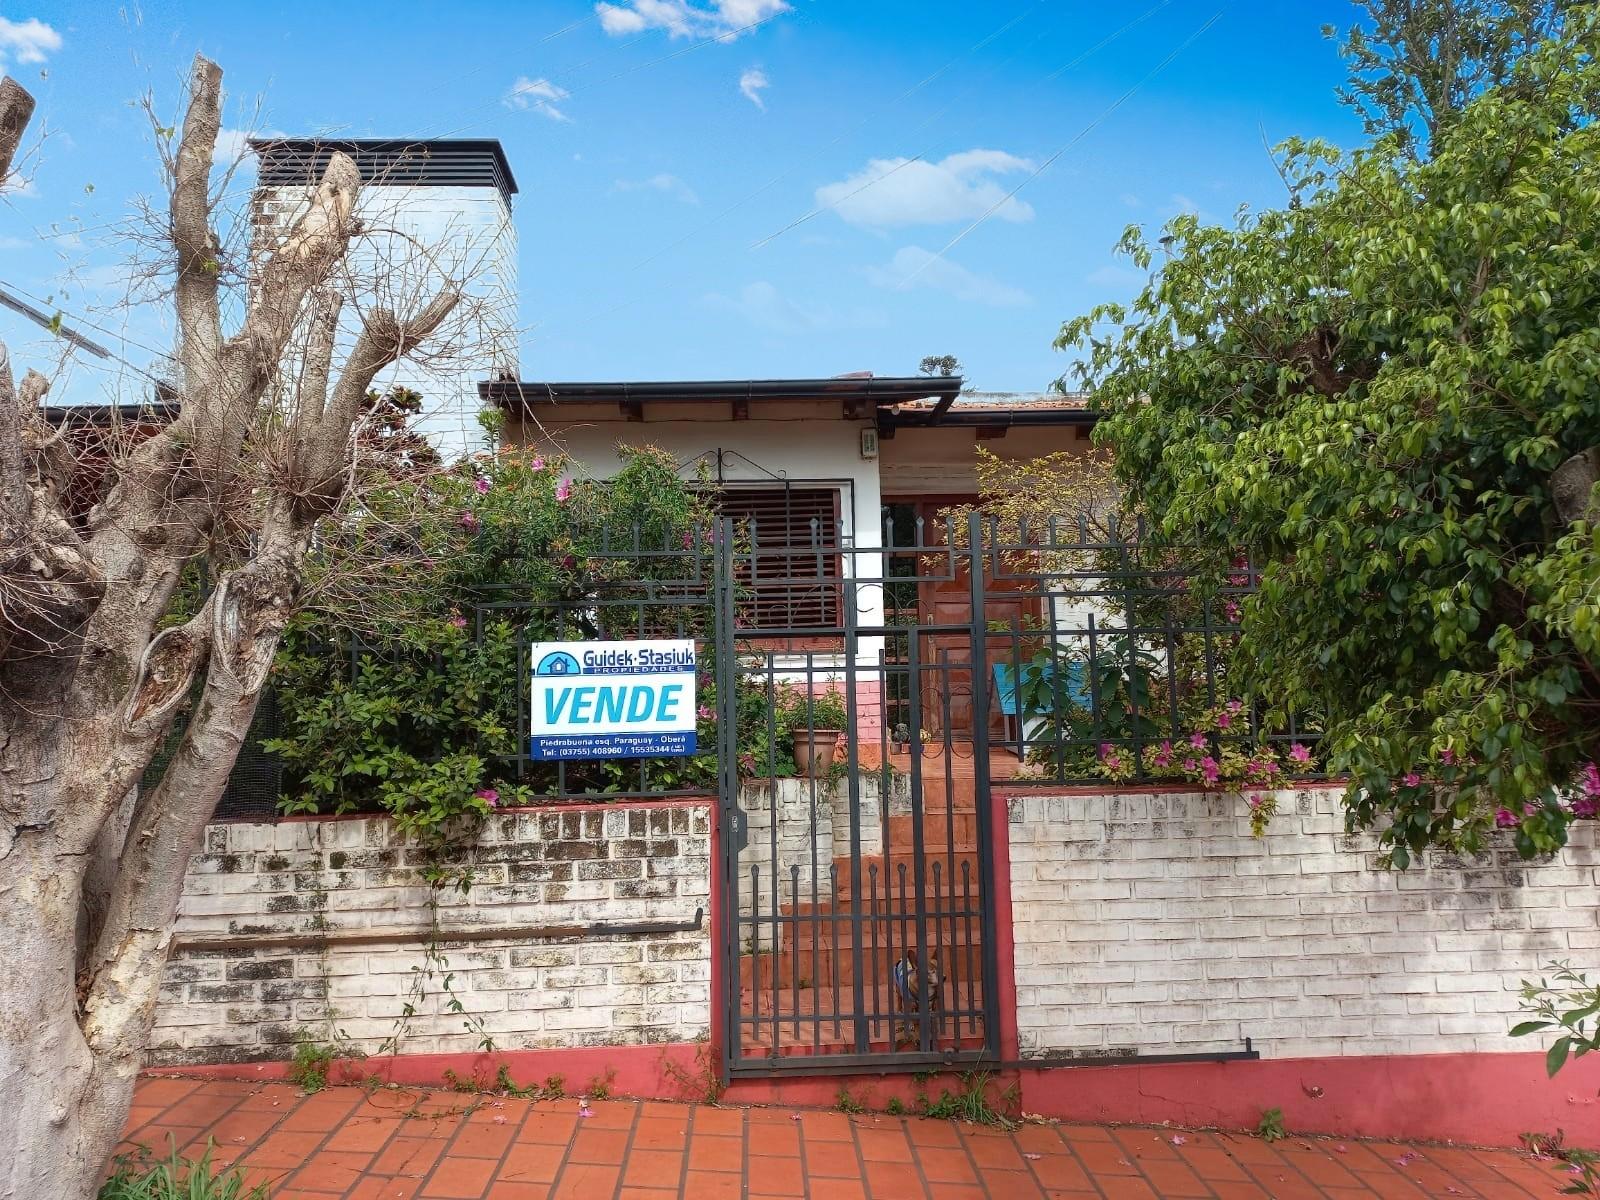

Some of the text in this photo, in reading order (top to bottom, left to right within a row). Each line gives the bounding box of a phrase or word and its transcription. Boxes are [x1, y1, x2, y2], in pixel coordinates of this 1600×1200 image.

[594, 665, 684, 673] PROPIEDADES
[545, 685, 683, 724] VENDE
[614, 736, 653, 745] Paraguay
[542, 748, 557, 756] Tel:
[559, 747, 590, 756] (03755)
